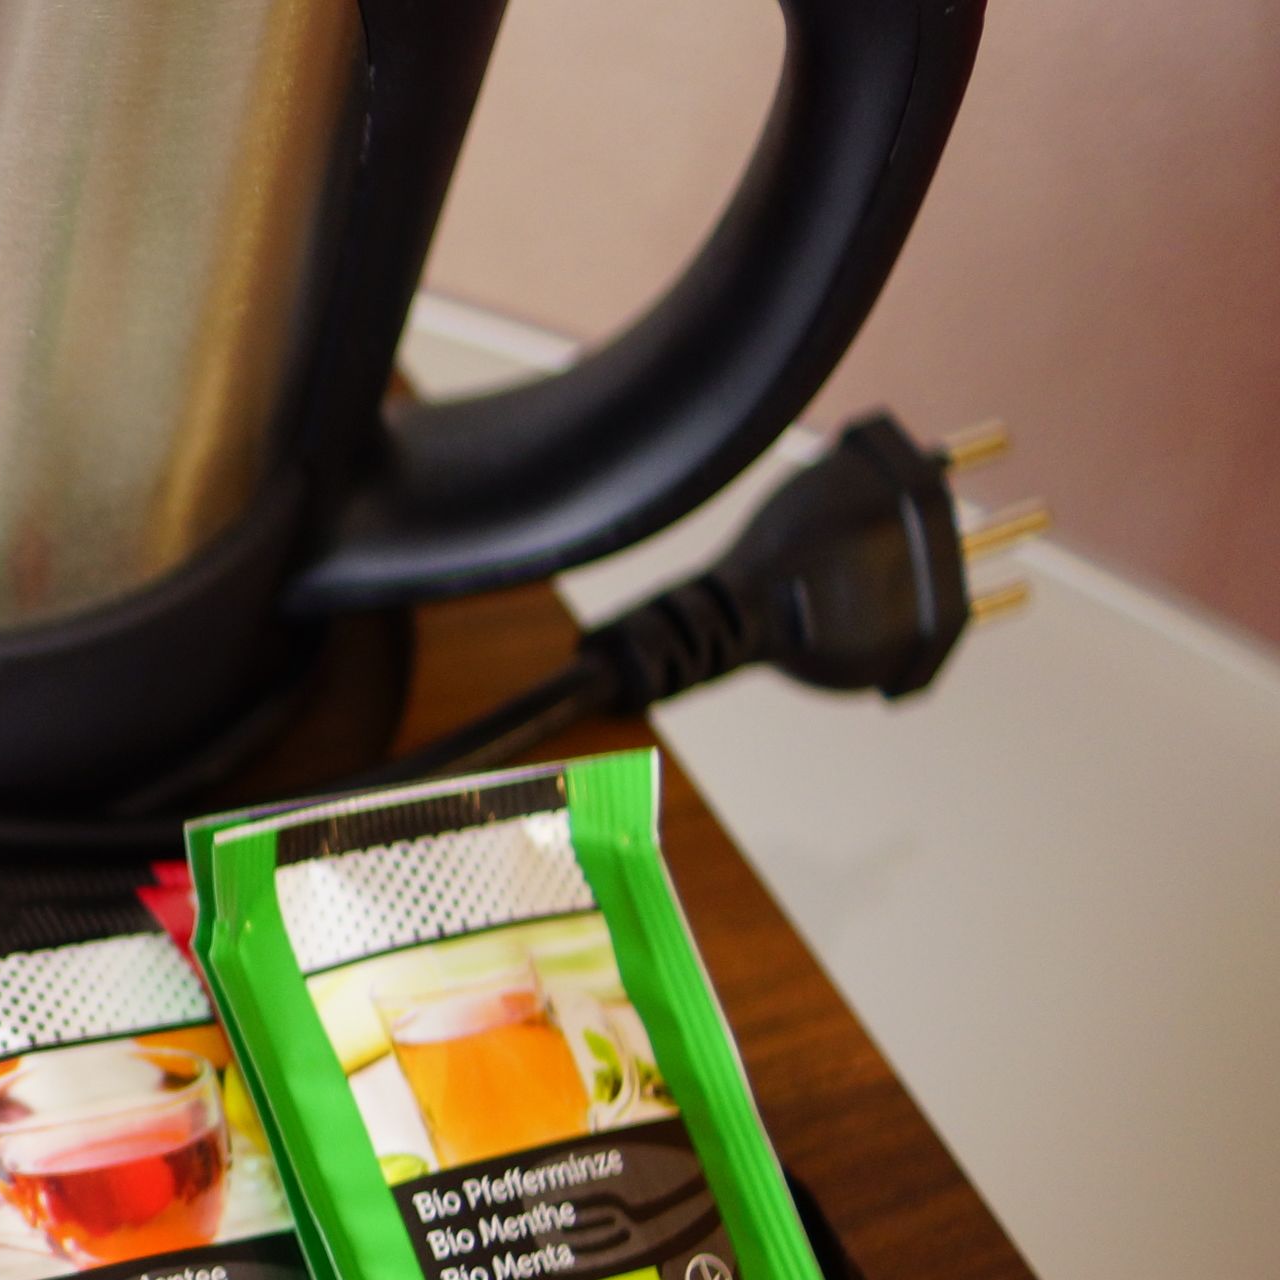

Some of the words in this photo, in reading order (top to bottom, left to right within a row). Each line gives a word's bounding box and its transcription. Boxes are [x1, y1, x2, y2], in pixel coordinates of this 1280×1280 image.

[413, 1183, 459, 1223] Bio
[465, 1148, 623, 1211] Pfefferminze
[427, 1224, 472, 1261] Bio
[479, 1200, 576, 1250] Menthe
